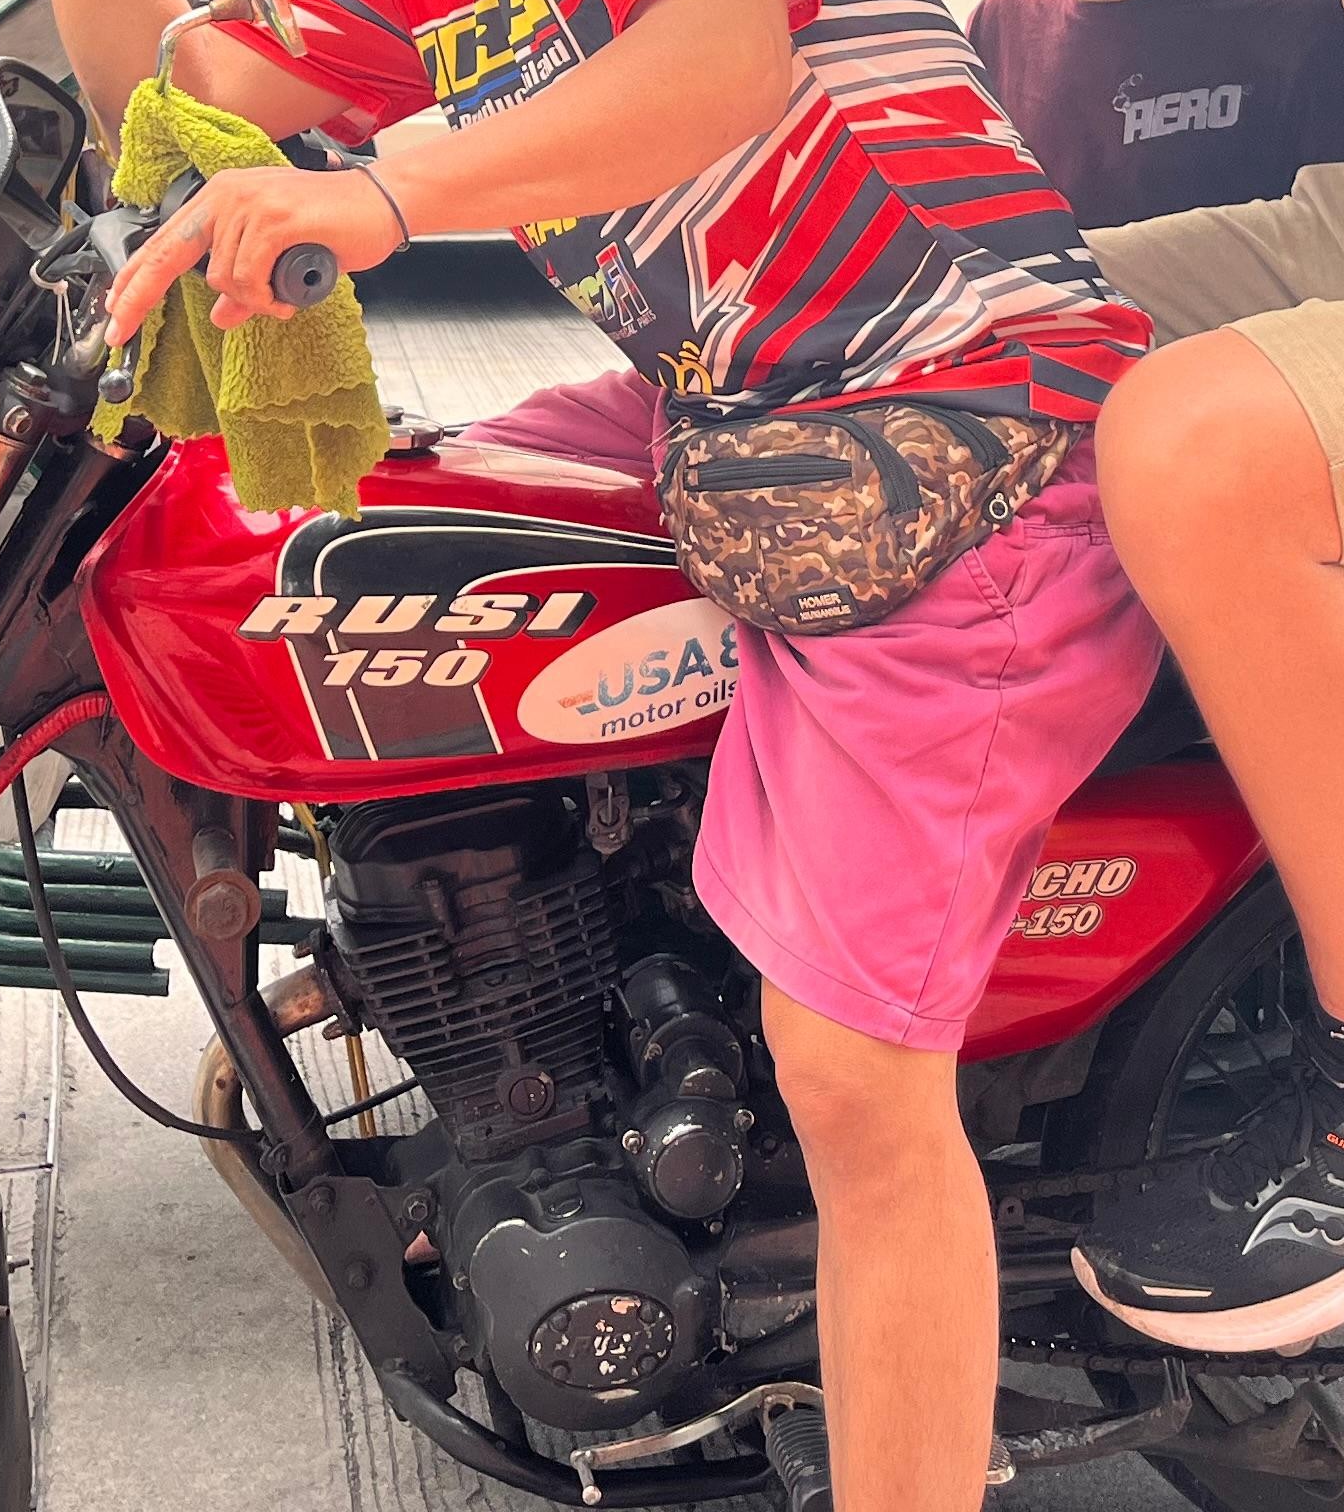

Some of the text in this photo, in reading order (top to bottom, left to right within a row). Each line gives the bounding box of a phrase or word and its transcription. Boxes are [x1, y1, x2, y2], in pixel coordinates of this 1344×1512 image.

[1123, 84, 1242, 144] AERO
[237, 592, 592, 638] RUSI
[321, 648, 493, 688] 150
[597, 637, 714, 708] USA
[601, 696, 686, 737] motor
[1023, 857, 1136, 900] CHO
[1007, 903, 1103, 937] -150
